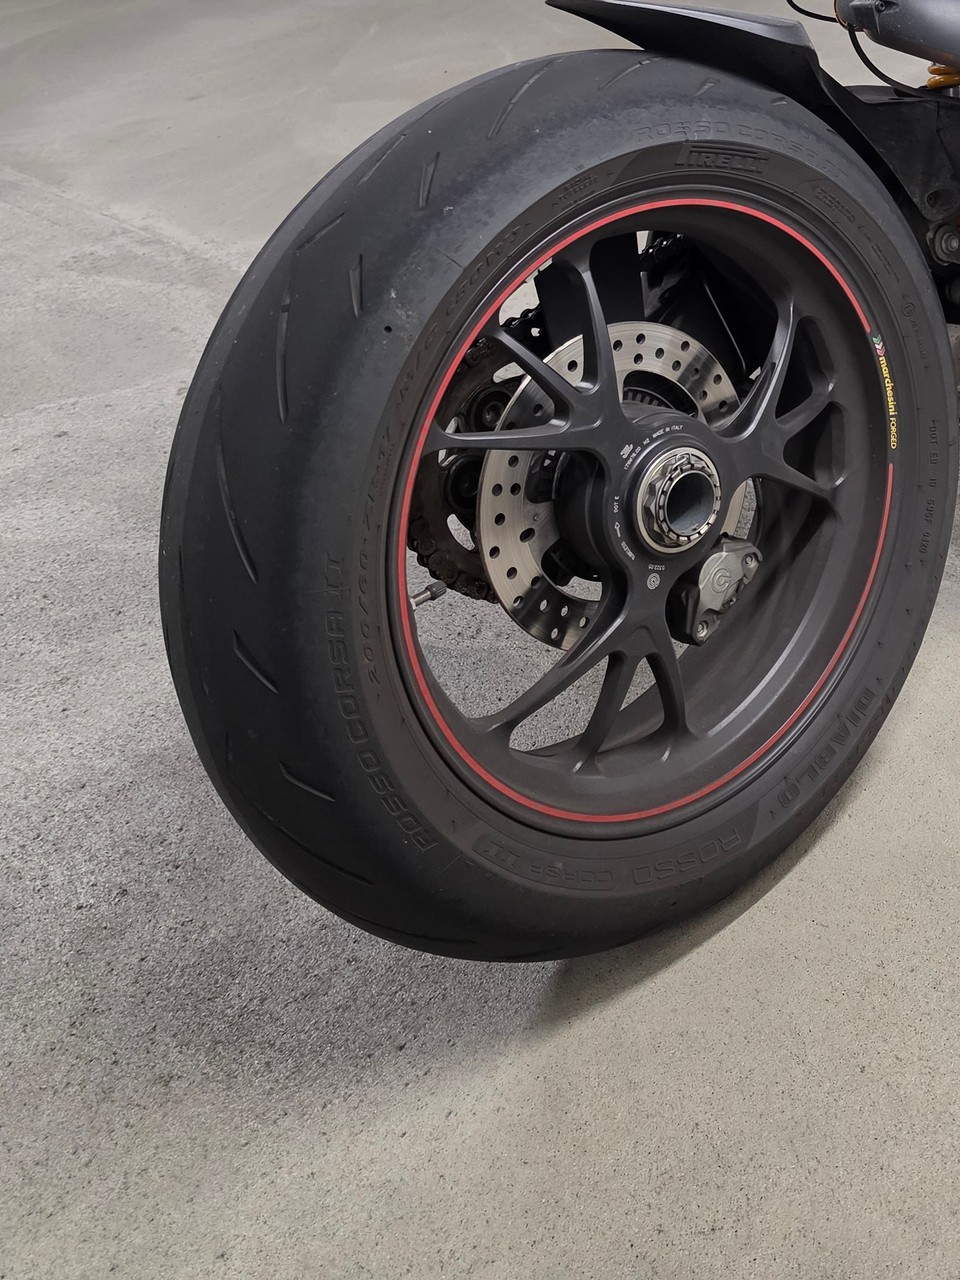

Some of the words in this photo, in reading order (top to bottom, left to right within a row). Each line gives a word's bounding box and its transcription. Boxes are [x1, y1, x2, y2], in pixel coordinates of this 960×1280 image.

[674, 140, 771, 177] PIRELLI
[880, 356, 898, 416] marchesini
[889, 417, 897, 449] FORGED
[775, 685, 878, 811] DIABLO
